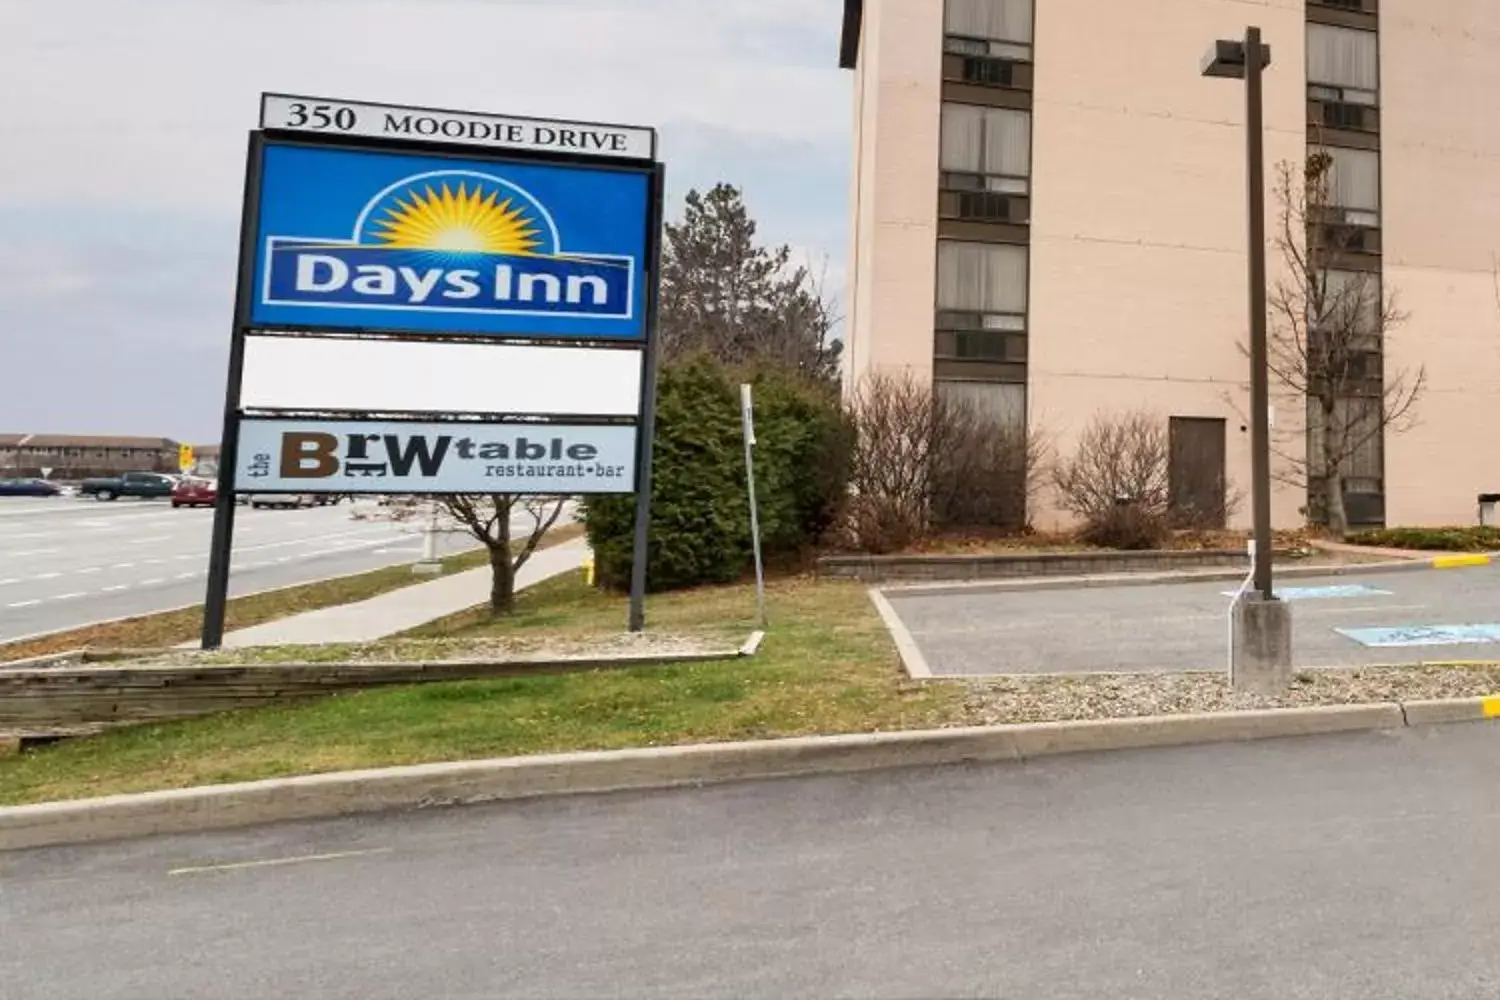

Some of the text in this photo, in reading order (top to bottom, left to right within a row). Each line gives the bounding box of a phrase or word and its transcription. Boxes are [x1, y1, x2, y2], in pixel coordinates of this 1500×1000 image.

[285, 102, 628, 152] 350 MOODIE DRIVE
[295, 253, 609, 305] Days Inn
[247, 452, 271, 478] the
[454, 436, 599, 462] table
